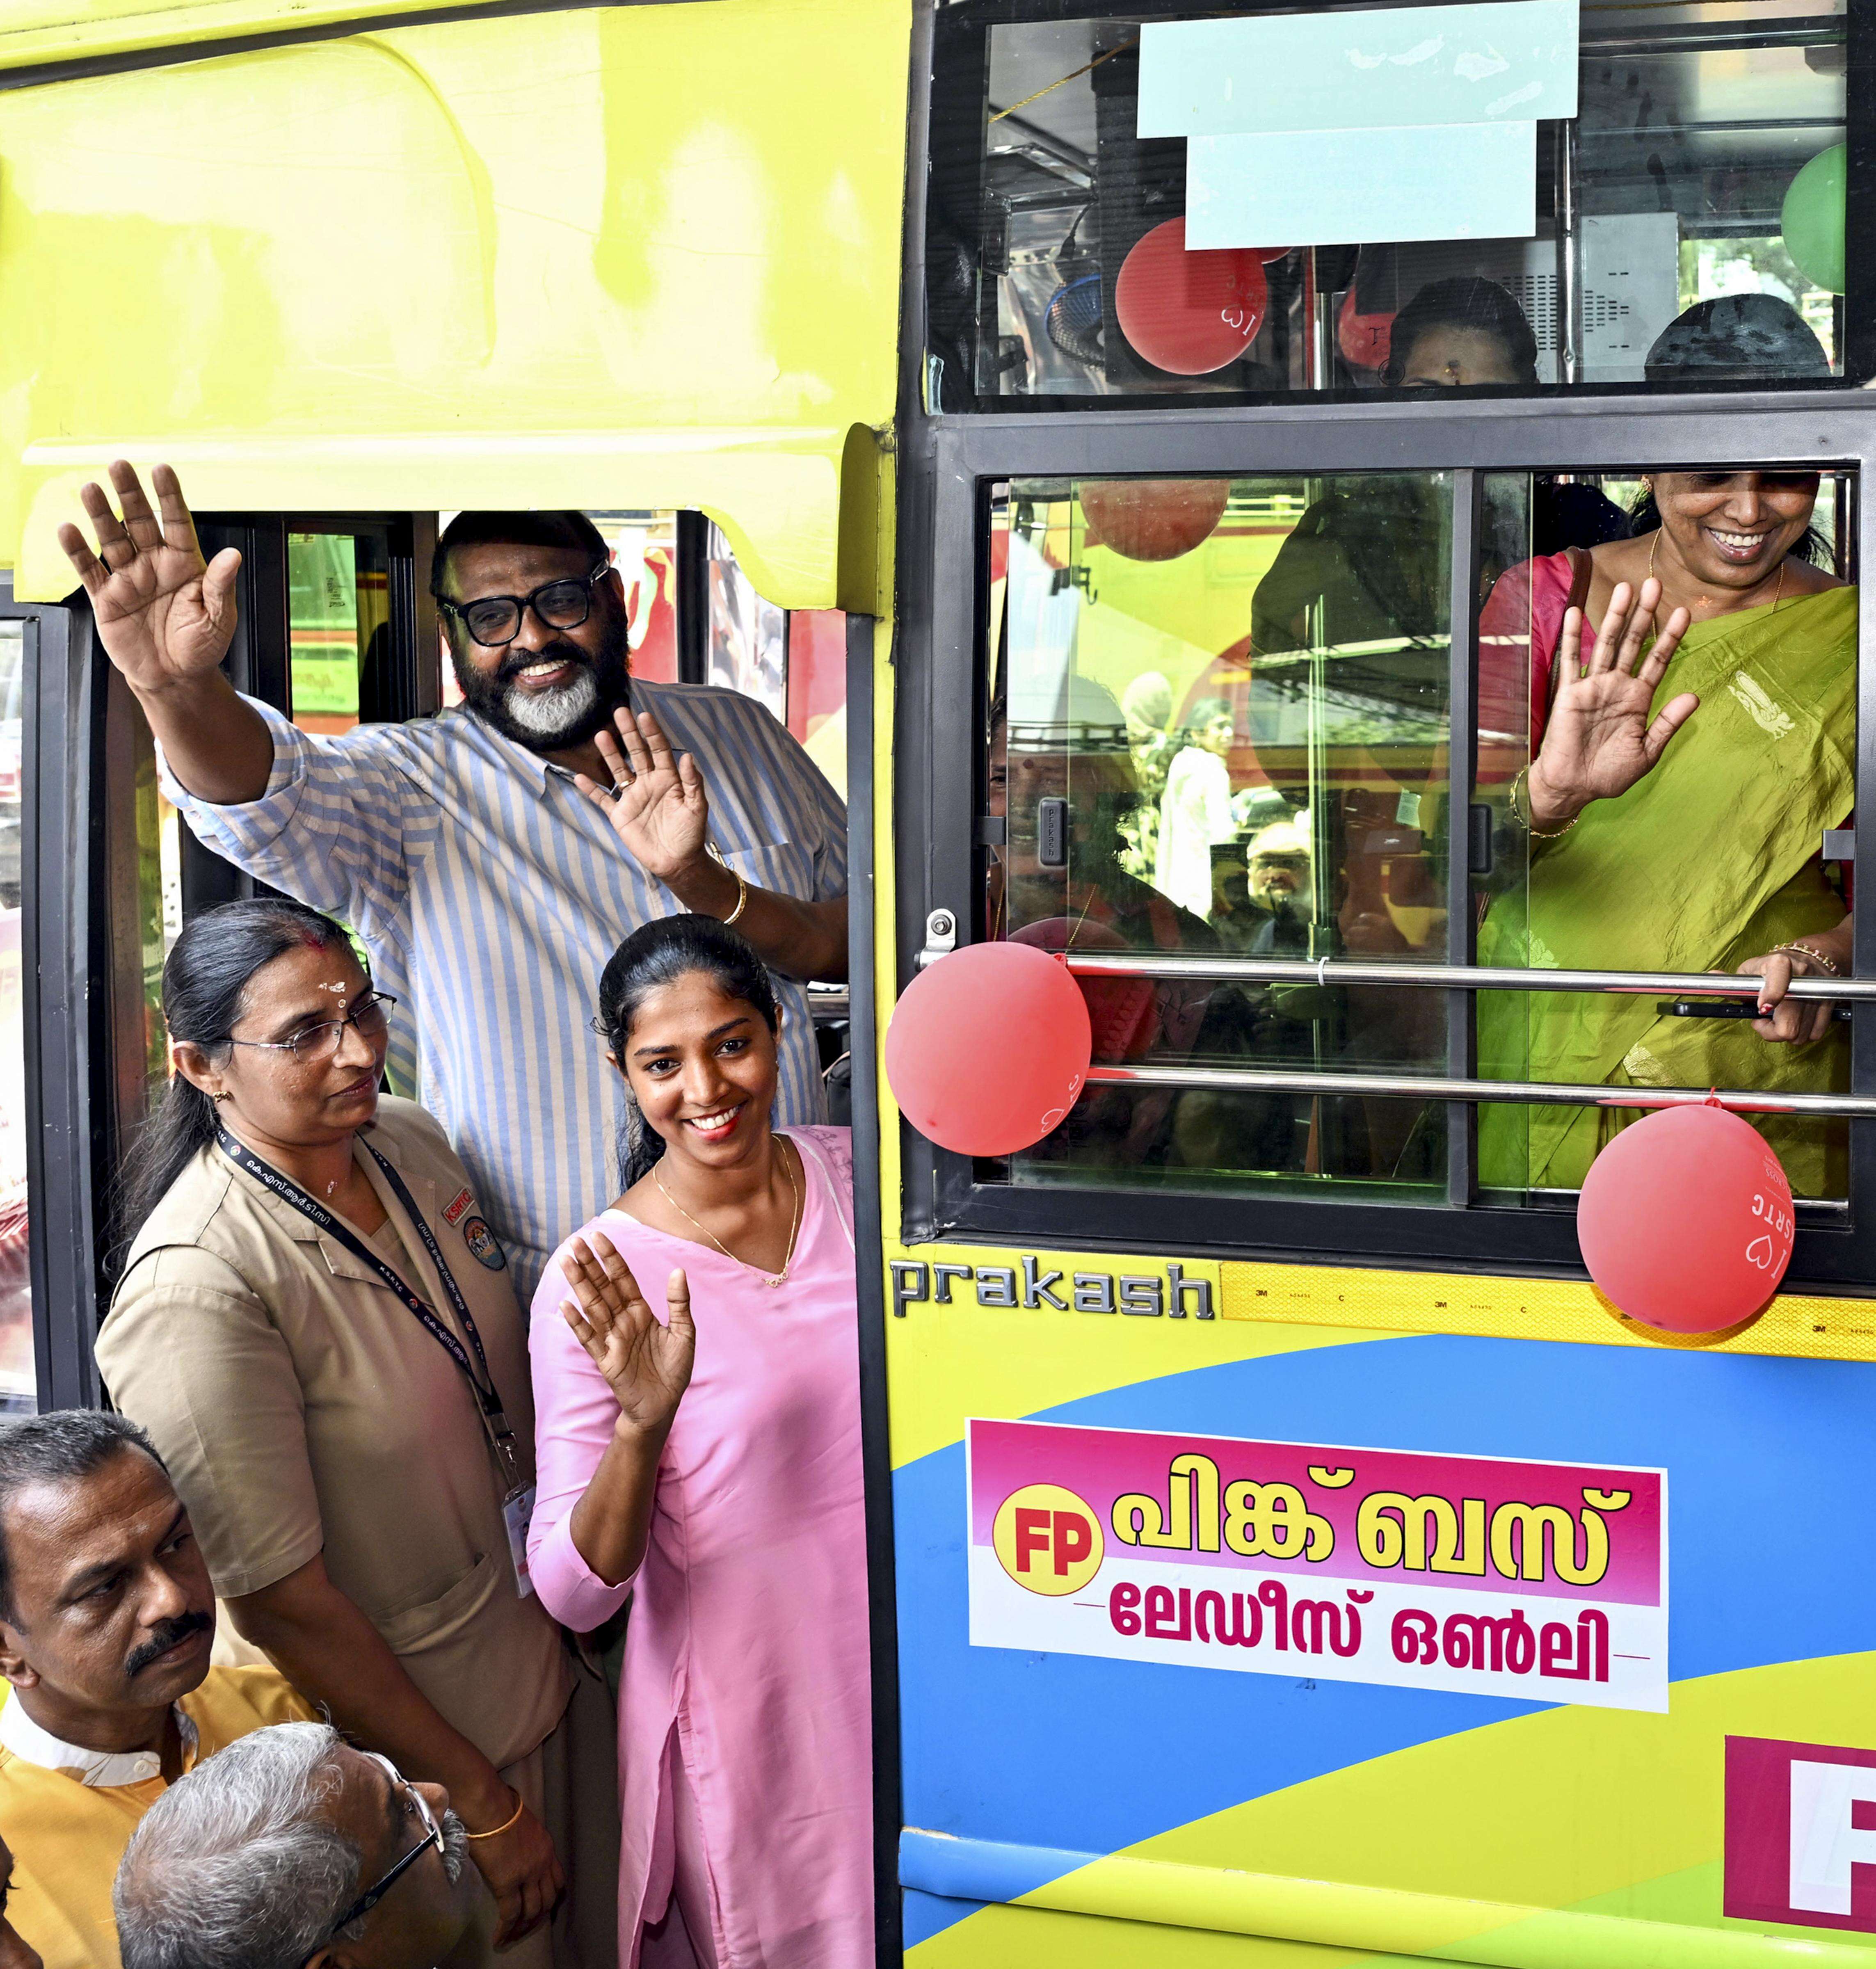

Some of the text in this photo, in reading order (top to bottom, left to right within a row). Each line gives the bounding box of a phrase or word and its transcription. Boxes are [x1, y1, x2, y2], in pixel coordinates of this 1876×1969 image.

[445, 1191, 471, 1222] KSRTC
[890, 1255, 1214, 1320] prakash
[1015, 1508, 1092, 1576] FP
[1111, 1453, 1632, 1585] പിങ്ക് ബസ്
[1109, 1579, 1373, 1658] ലേഡീസ്
